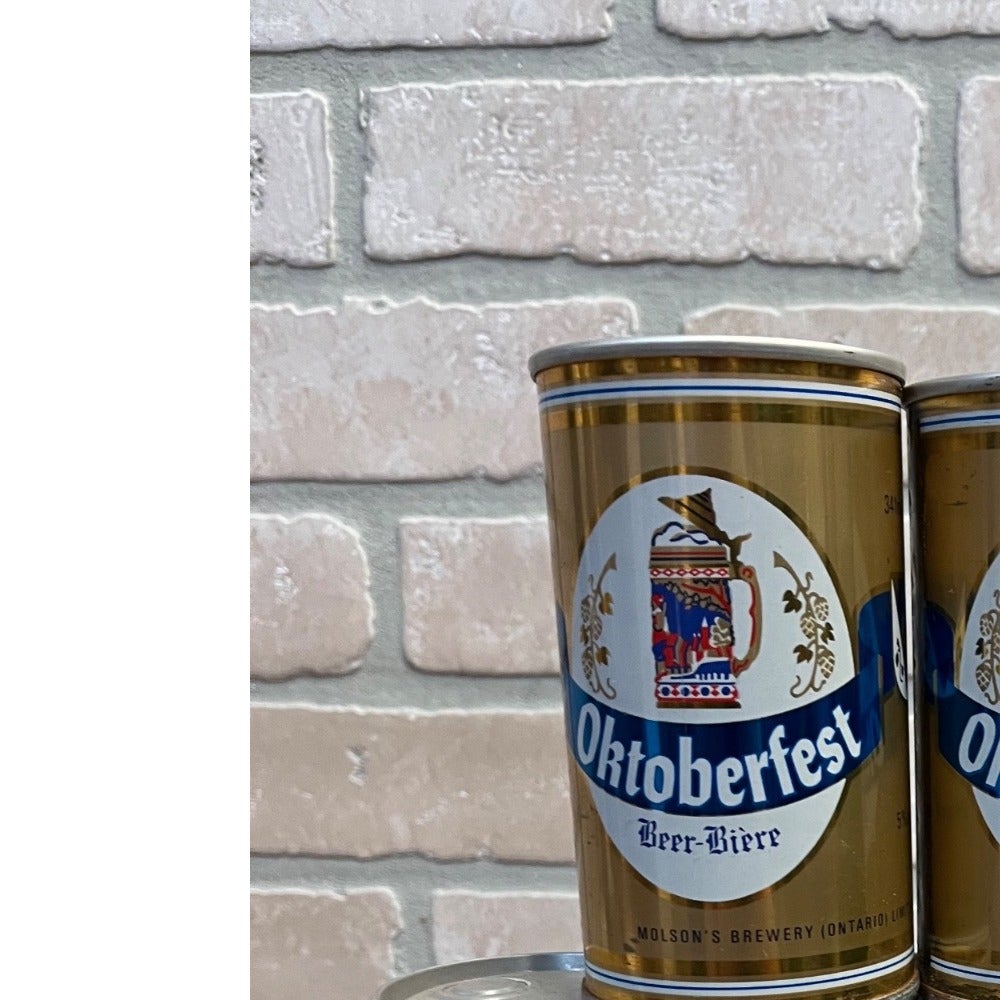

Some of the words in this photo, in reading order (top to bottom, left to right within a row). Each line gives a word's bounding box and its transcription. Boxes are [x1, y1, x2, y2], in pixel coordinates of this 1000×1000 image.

[577, 702, 862, 807] Oktoberfest
[637, 818, 781, 855] Beer-Bière
[637, 926, 721, 944] MOLSON'S
[731, 925, 814, 944] BREWERY
[821, 913, 888, 939] (ONTARIO)
